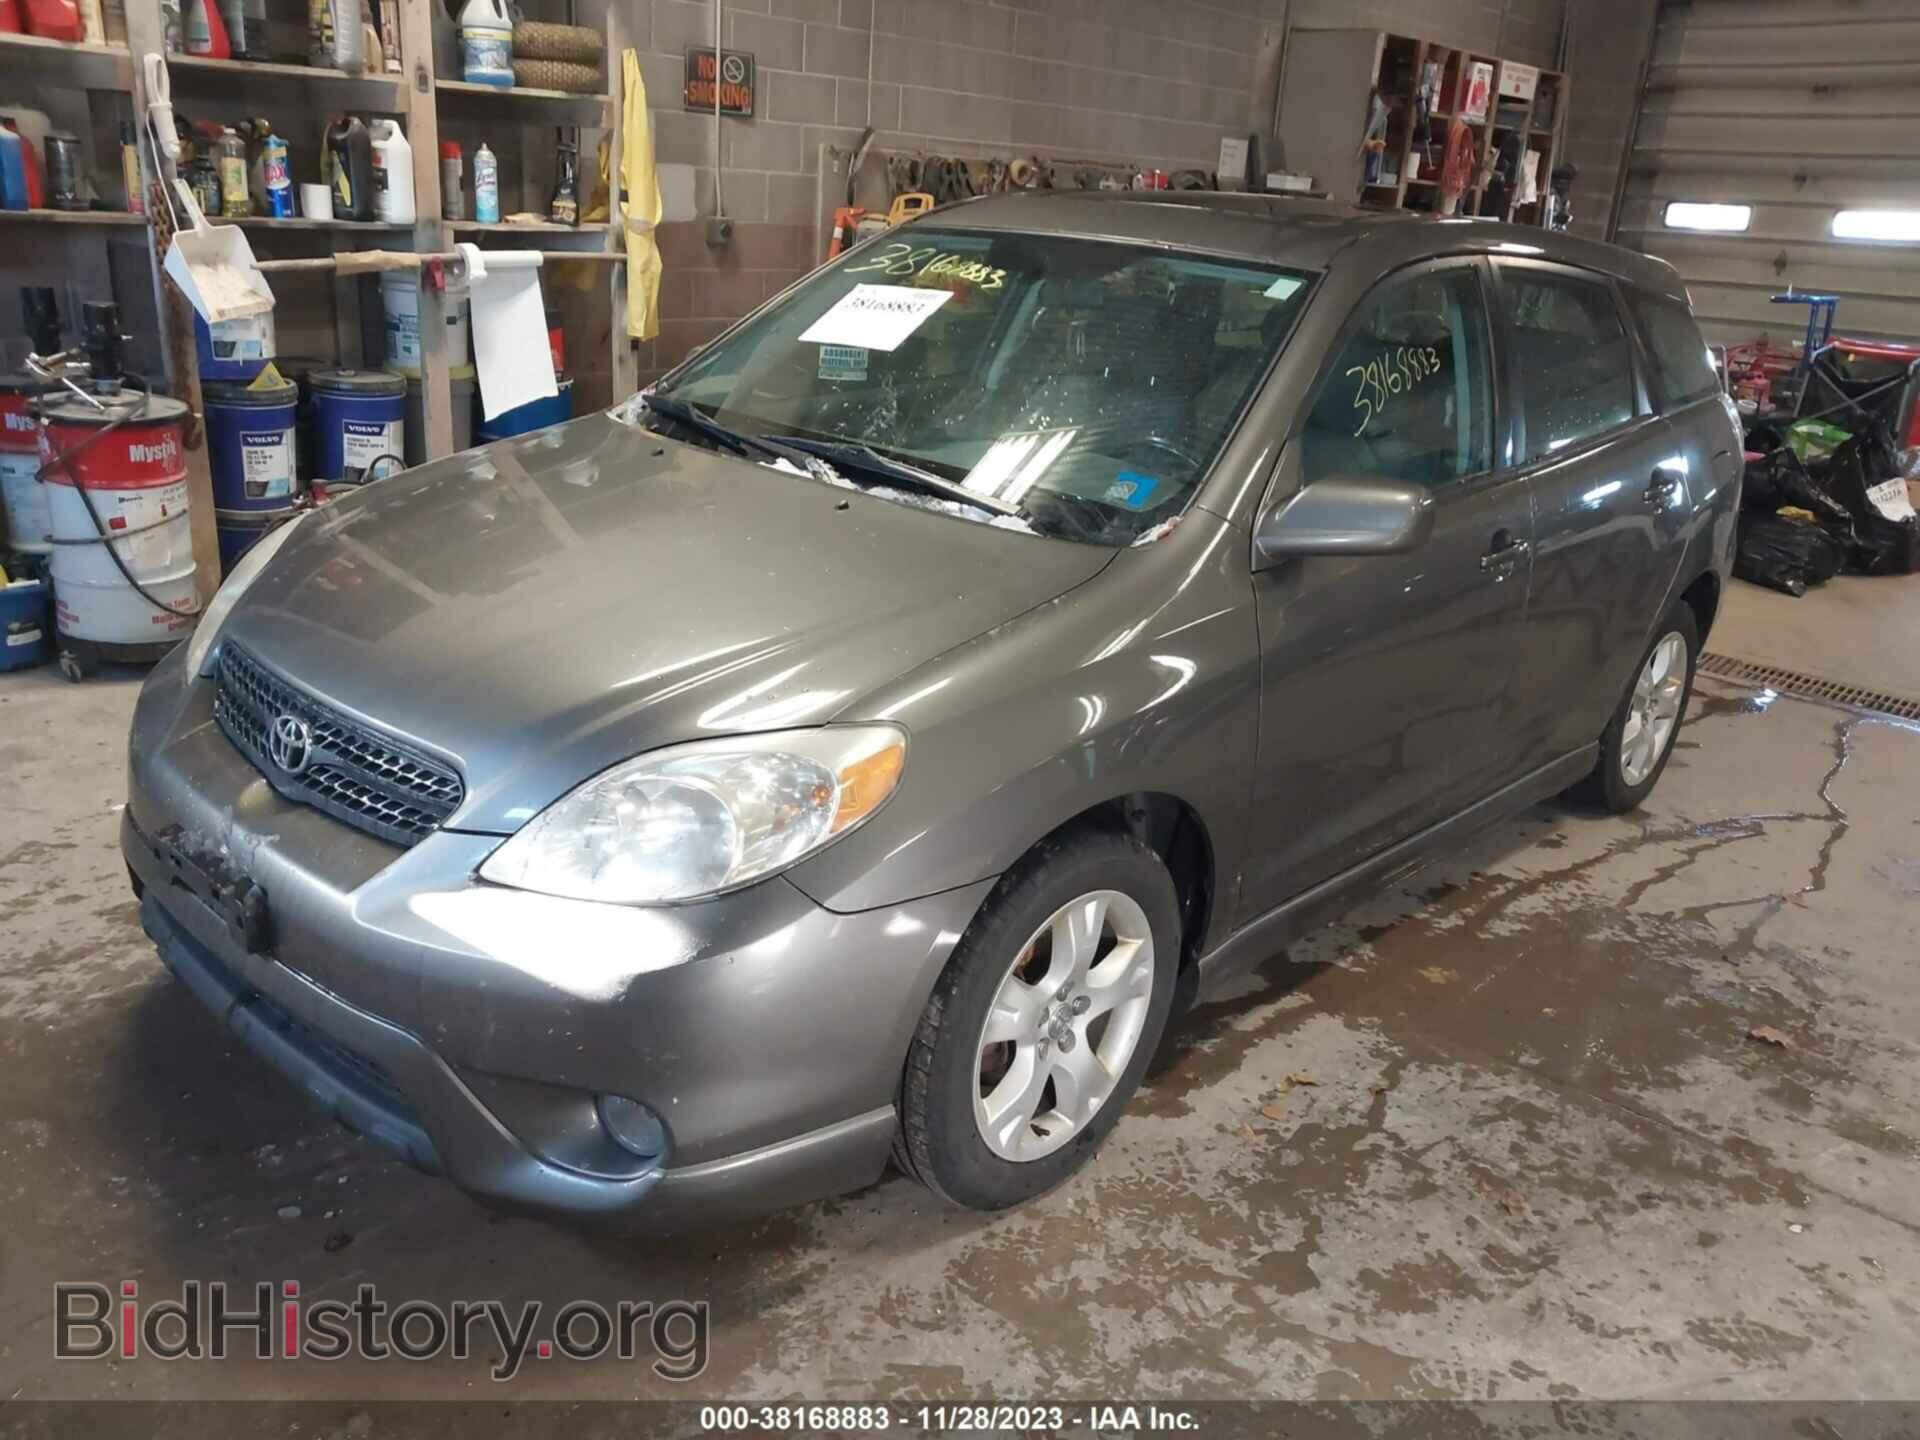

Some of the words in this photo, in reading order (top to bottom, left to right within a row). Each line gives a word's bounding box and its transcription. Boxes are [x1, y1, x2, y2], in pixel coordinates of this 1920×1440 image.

[697, 54, 719, 80] NO
[688, 81, 749, 108] SMOKING
[1345, 346, 1441, 438] 38168883
[246, 435, 280, 443] VOLVO
[347, 424, 381, 433] VOLVO
[128, 440, 177, 463] Mystik
